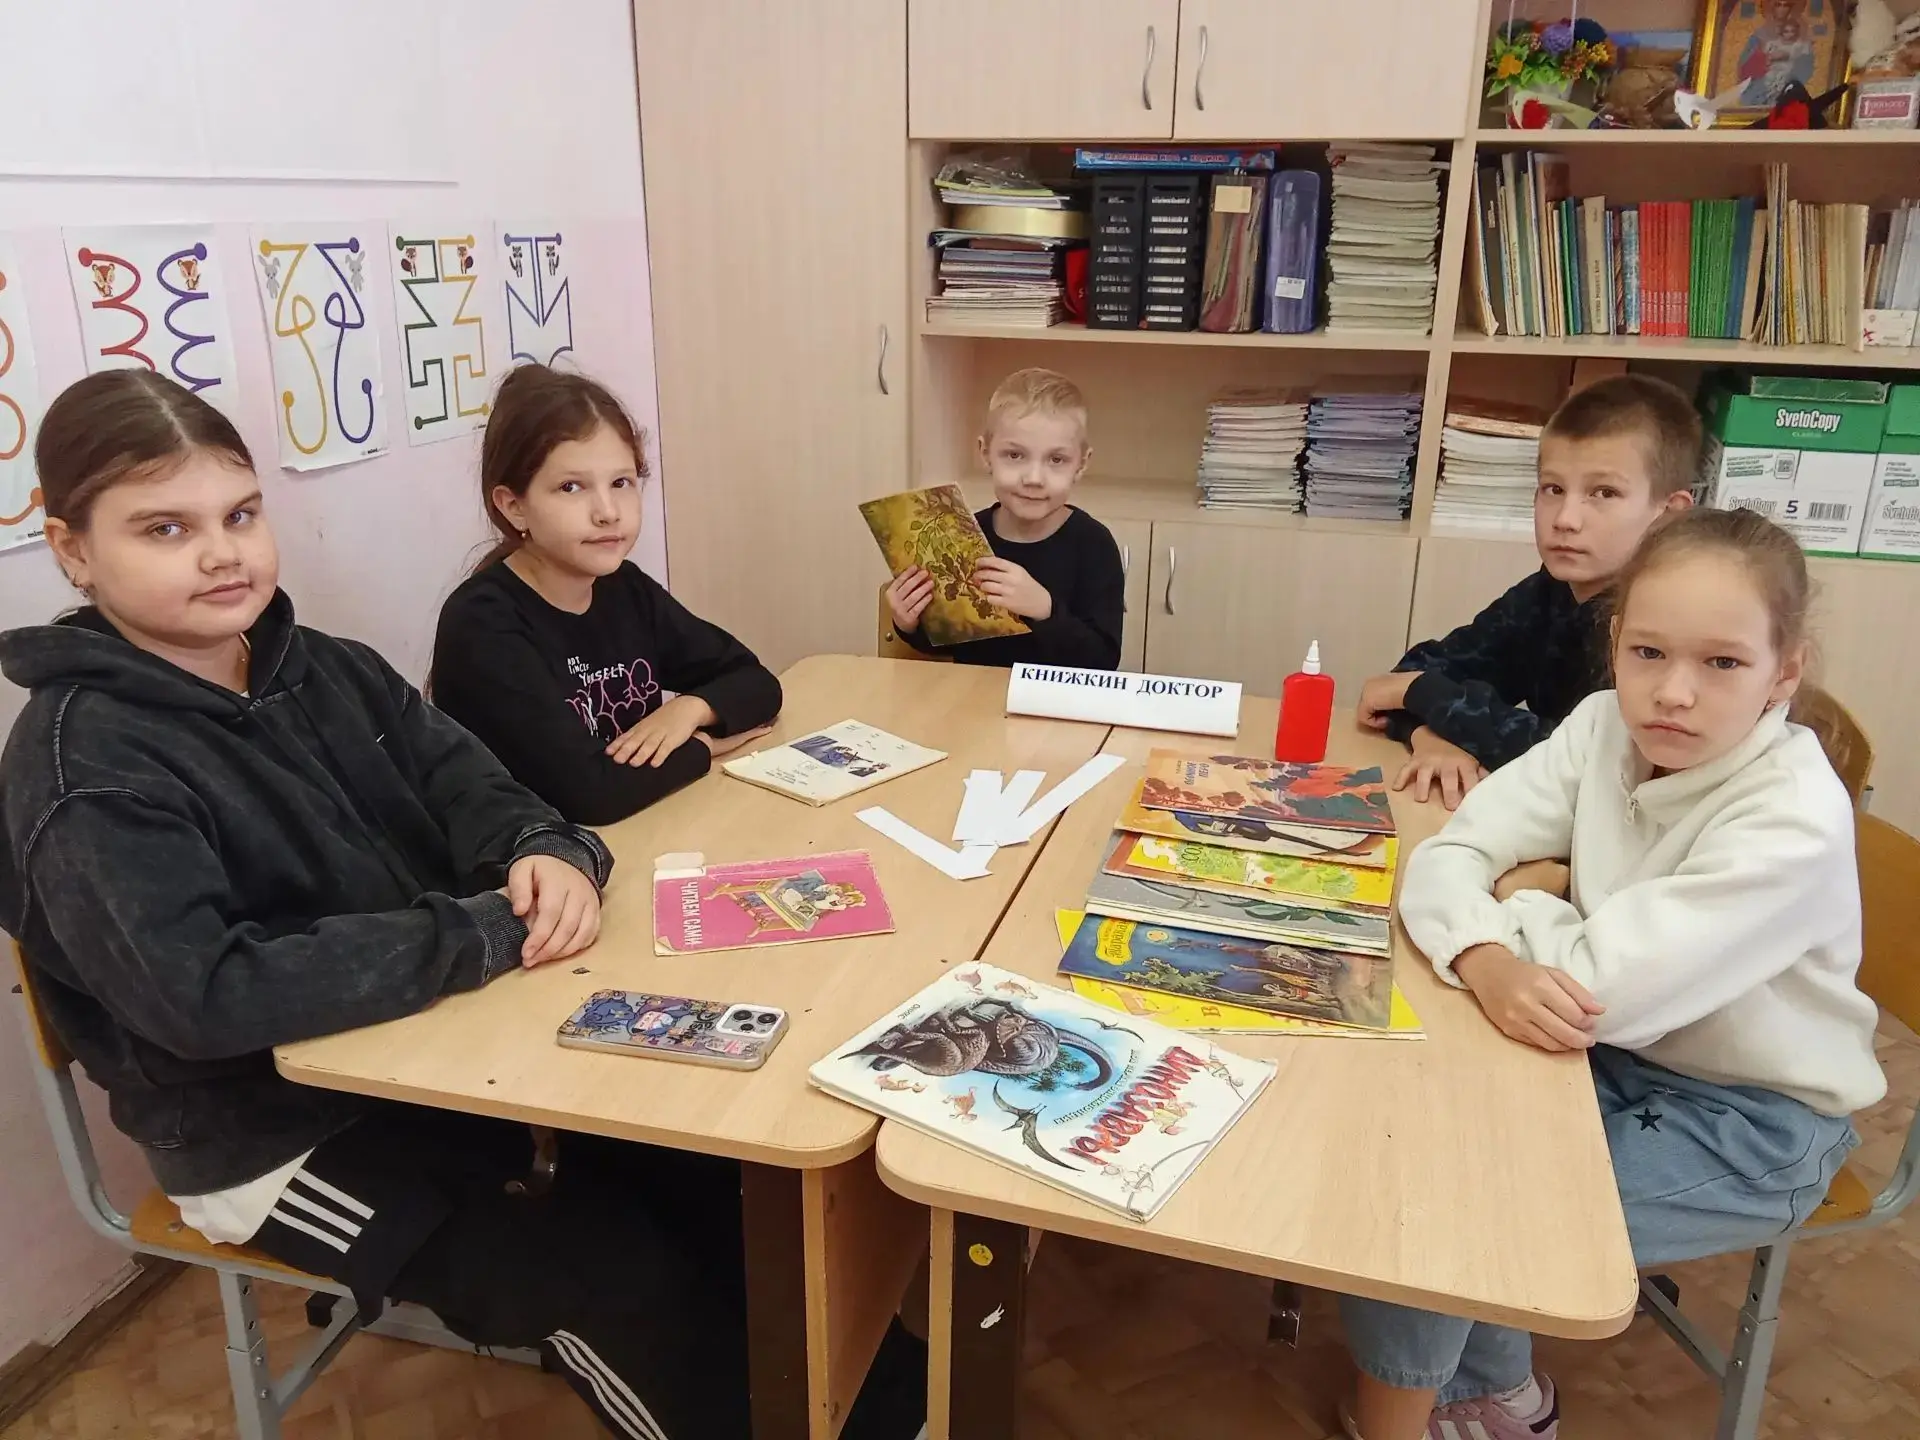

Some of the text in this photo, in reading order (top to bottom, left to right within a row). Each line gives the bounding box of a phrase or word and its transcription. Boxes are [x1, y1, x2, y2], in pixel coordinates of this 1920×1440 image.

[1775, 408, 1841, 433] SvetoCopy
[1786, 499, 1799, 514] 5
[1020, 667, 1224, 699] КНИЖКИН ДОКТОР
[680, 881, 703, 945] ЧИТАЕМ САМИ
[1066, 1046, 1205, 1166] ДИНОЗАВРЫ
